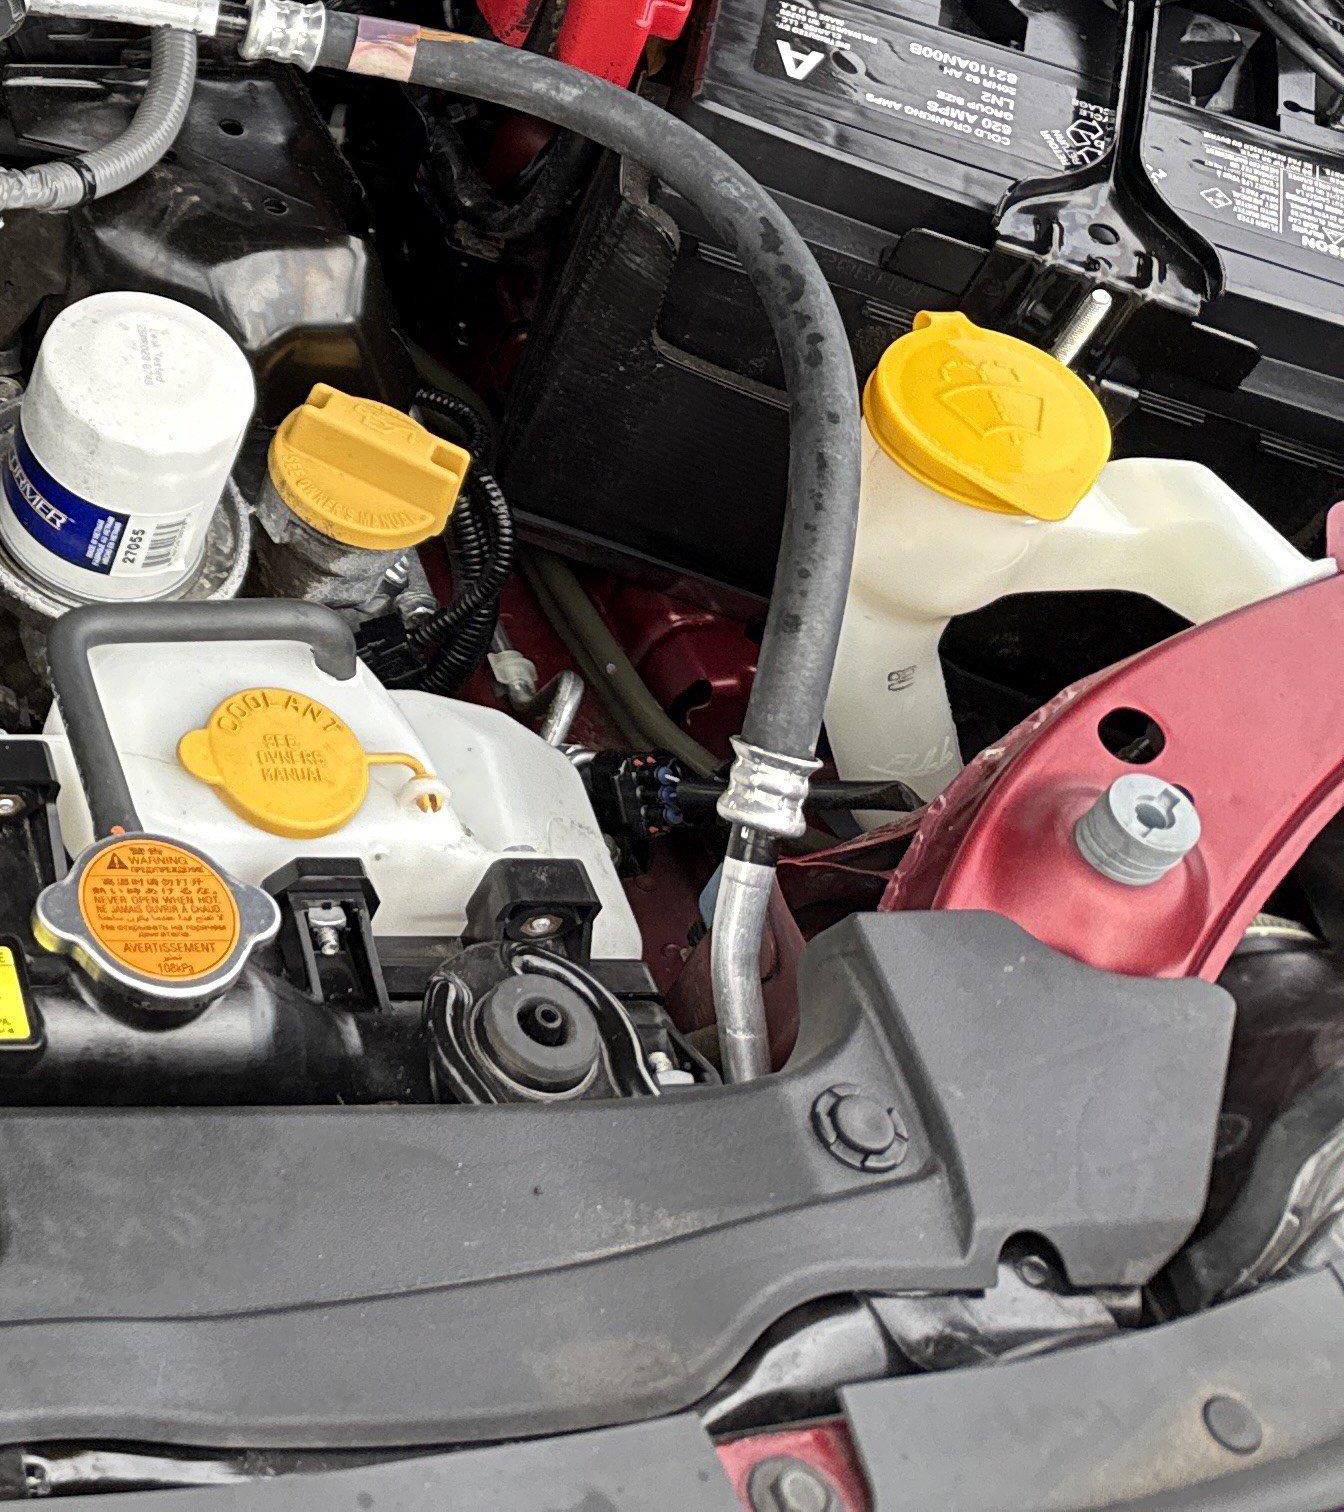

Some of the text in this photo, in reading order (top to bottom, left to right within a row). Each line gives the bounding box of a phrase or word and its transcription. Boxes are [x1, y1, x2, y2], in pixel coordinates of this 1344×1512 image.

[935, 89, 1014, 121] GROUP SIZE
[980, 90, 1015, 111] LN2
[866, 93, 1011, 146] COLD CRANKING AMPS
[926, 100, 1013, 136] 620 AMPS
[1040, 130, 1072, 166] RETOUR
[1051, 129, 1083, 166] RETURN
[121, 529, 145, 564] 27055
[217, 691, 342, 735] COOLANT
[261, 767, 327, 783] MANUAL
[127, 855, 189, 865] WARNING
[93, 895, 127, 905] NEVER
[131, 895, 159, 905] OPEN
[162, 895, 193, 905] WHEN
[123, 942, 216, 953] AVERTISSEMENT
